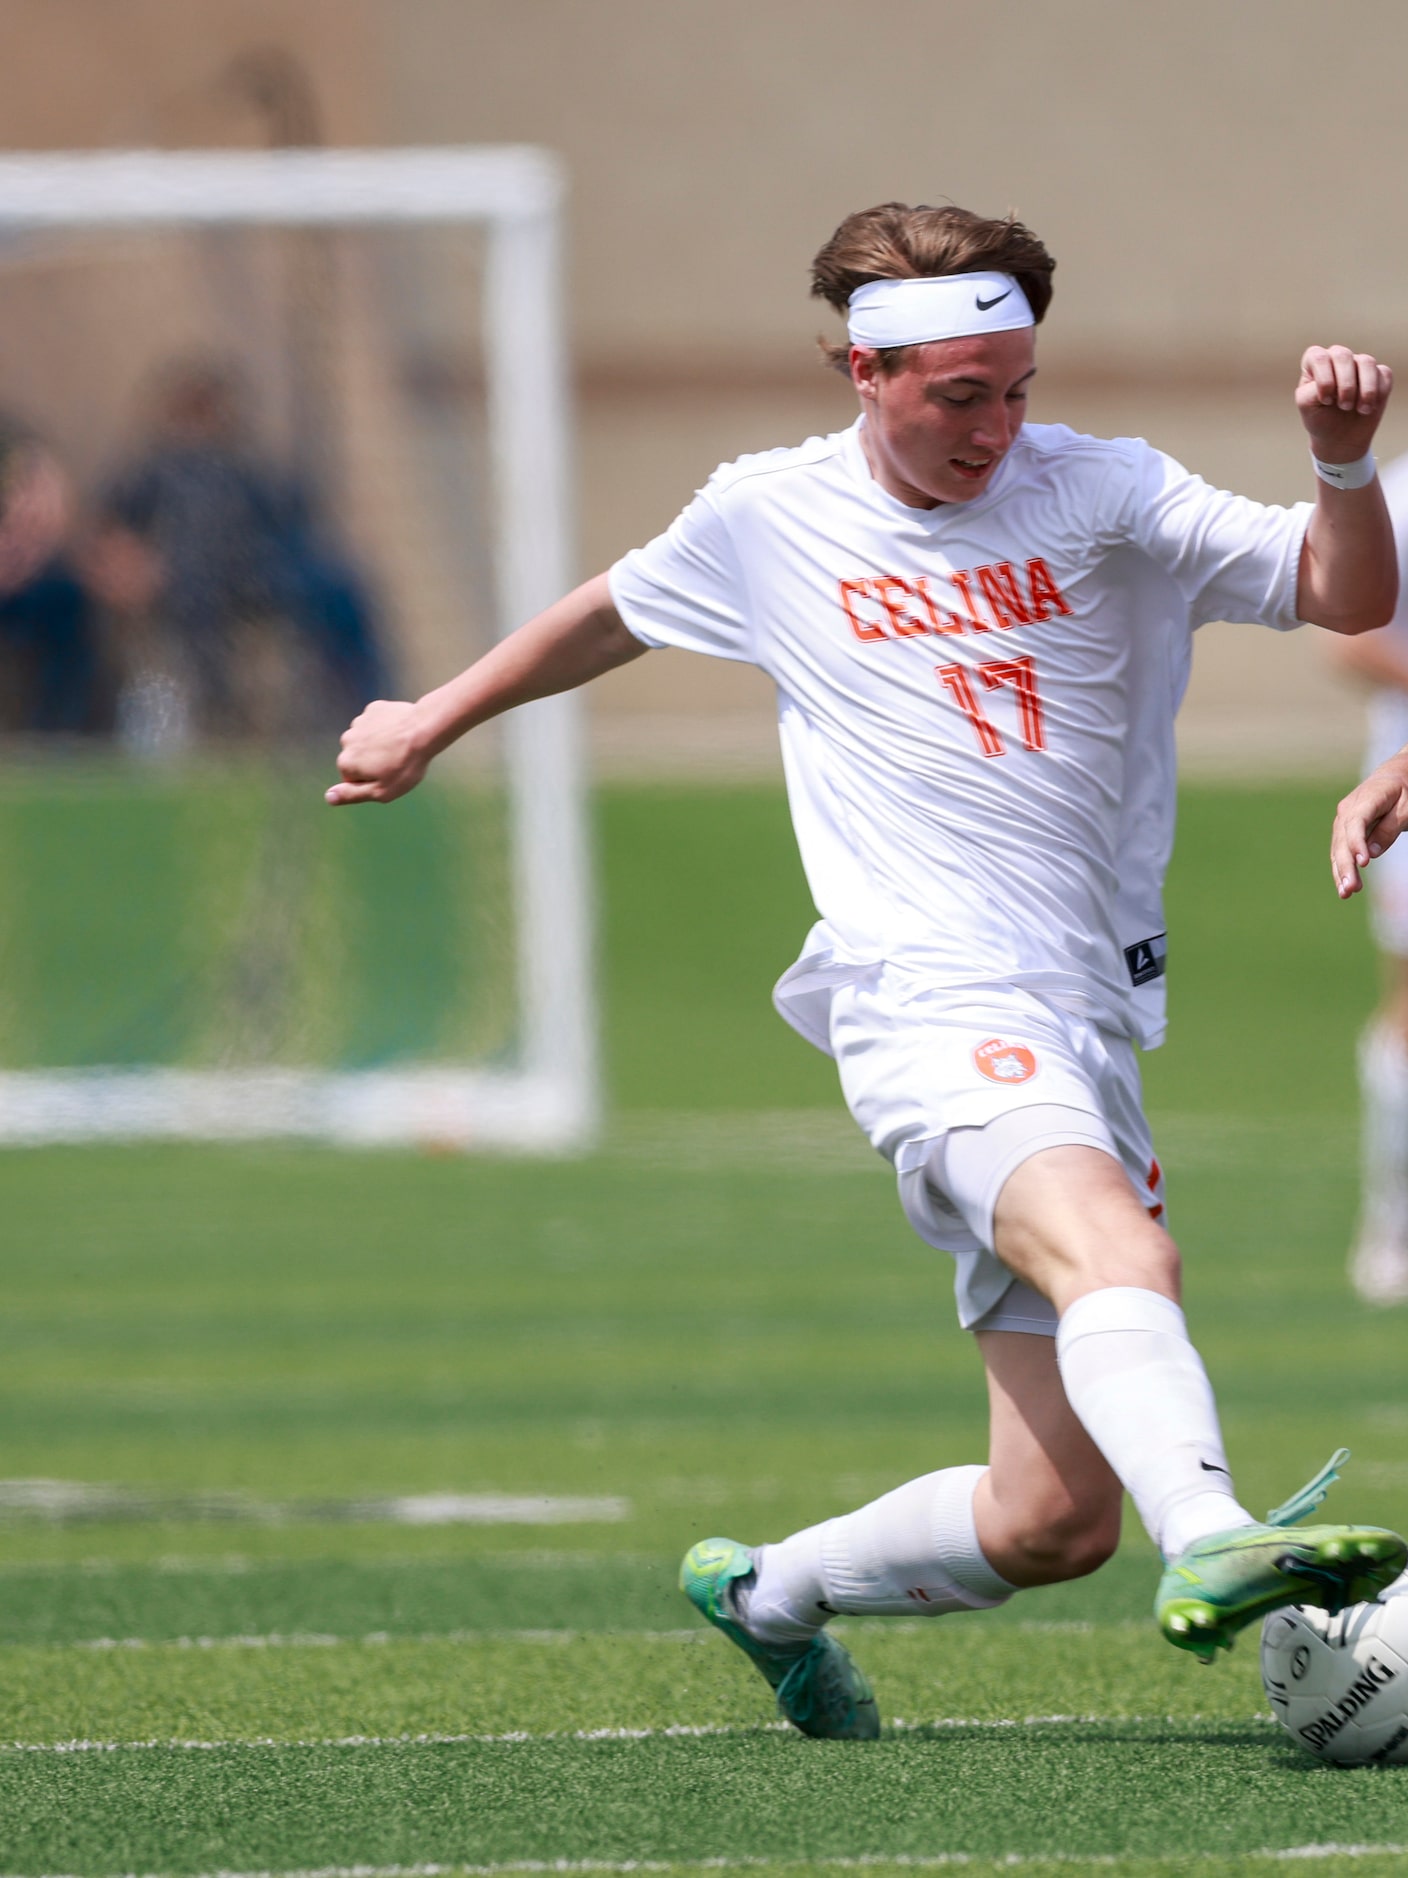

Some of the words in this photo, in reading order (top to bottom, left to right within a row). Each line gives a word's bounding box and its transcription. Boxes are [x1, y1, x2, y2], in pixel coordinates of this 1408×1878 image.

[839, 557, 1074, 642] CELINA
[934, 655, 1049, 758] 17
[1299, 1654, 1397, 1752] SPALDING
